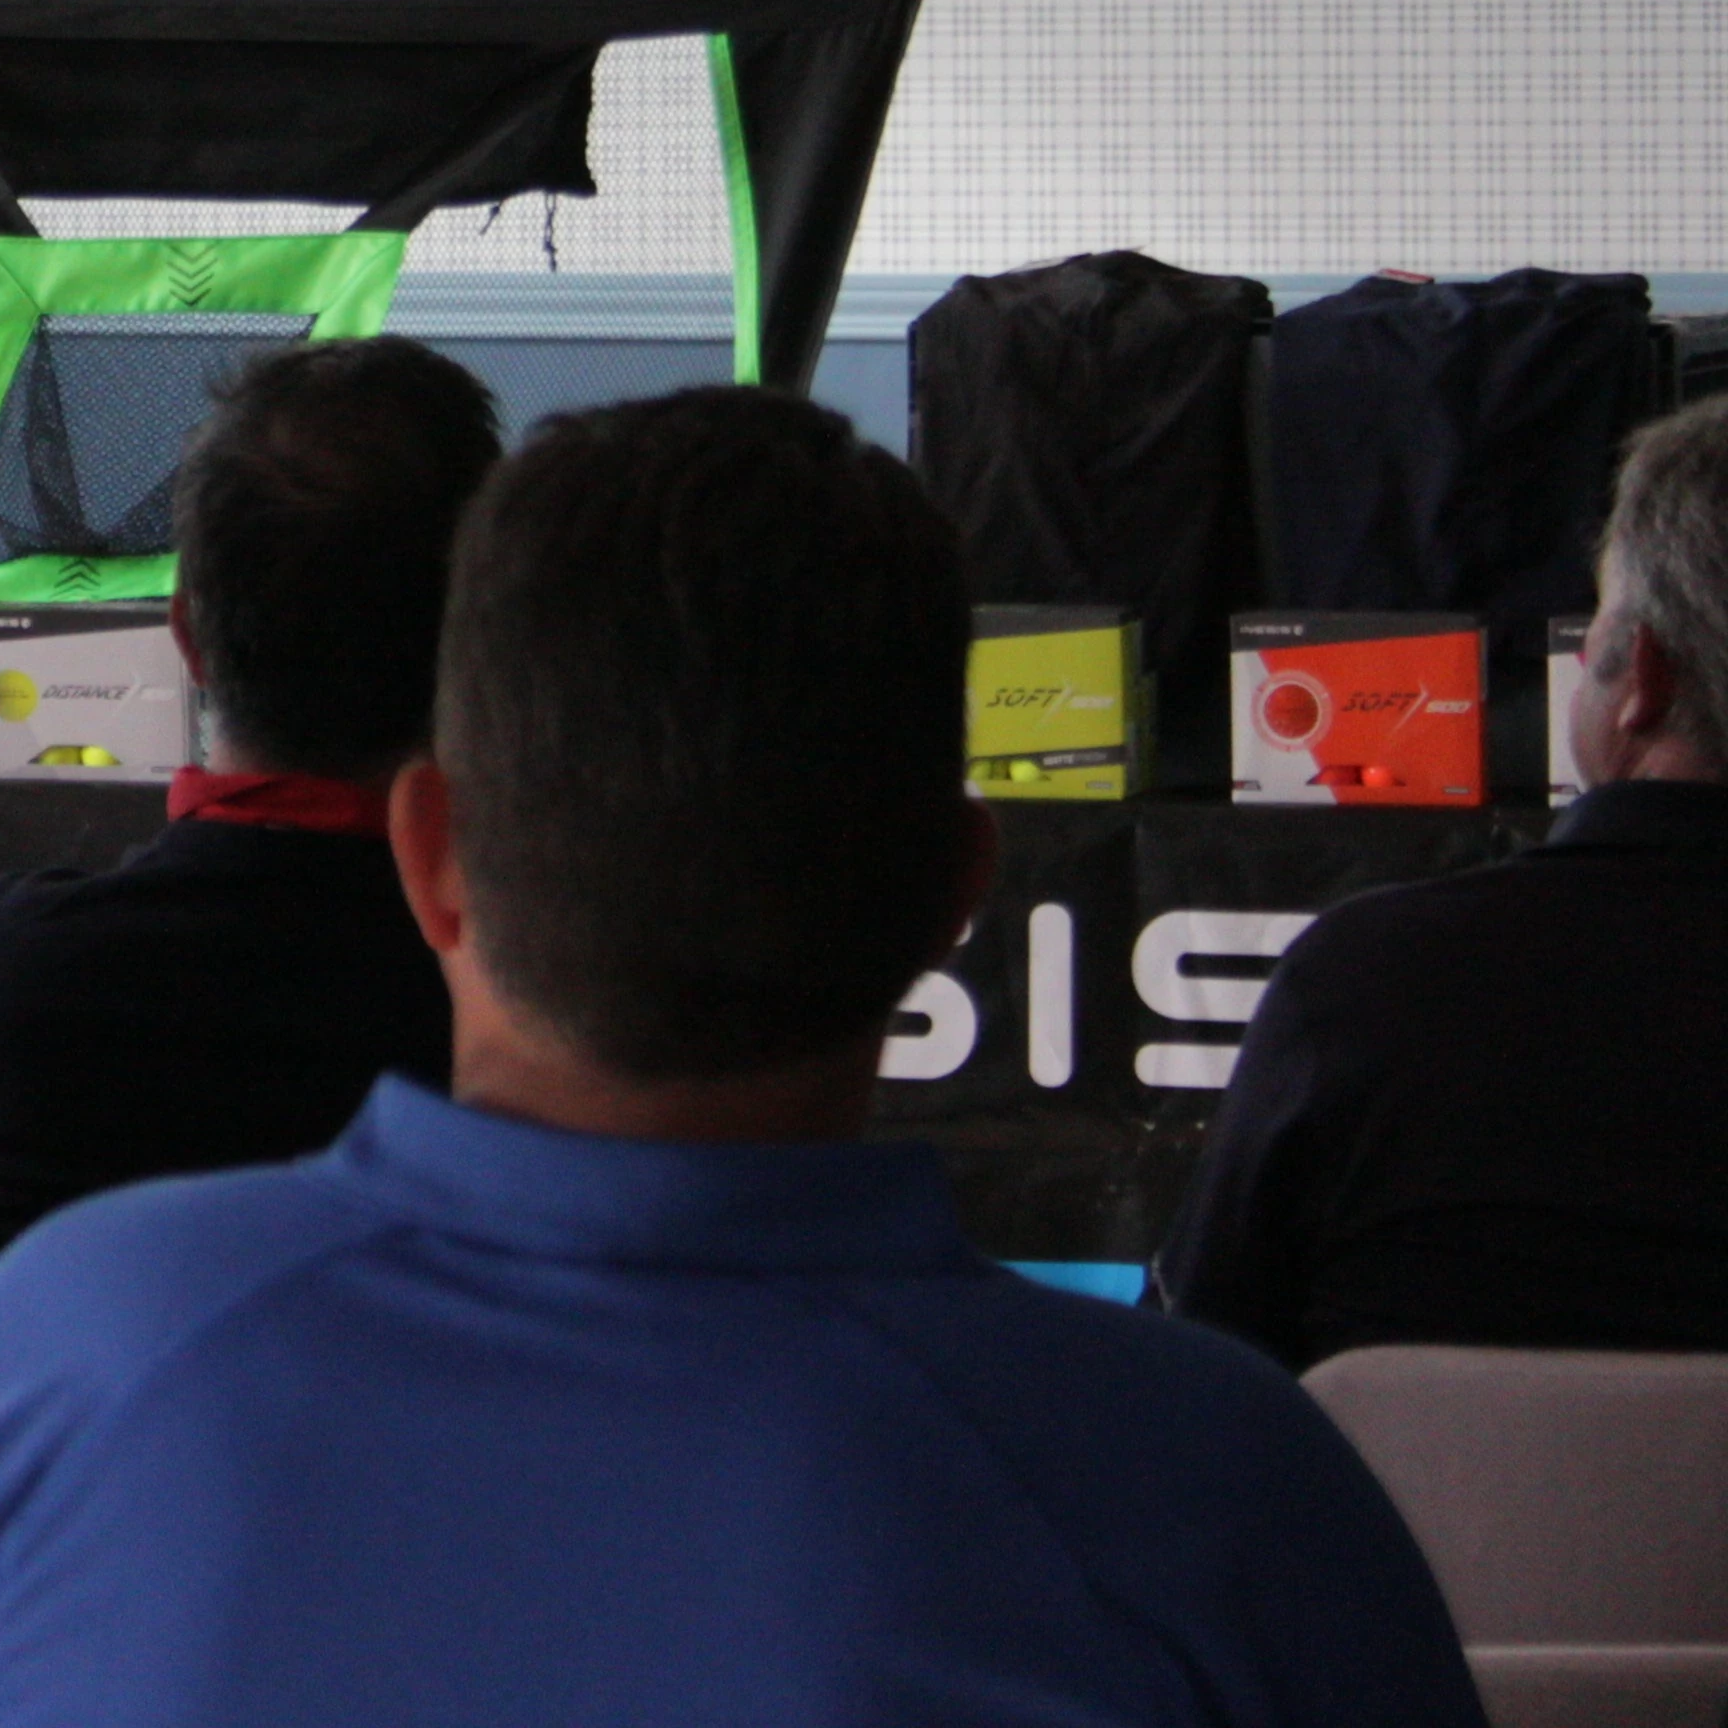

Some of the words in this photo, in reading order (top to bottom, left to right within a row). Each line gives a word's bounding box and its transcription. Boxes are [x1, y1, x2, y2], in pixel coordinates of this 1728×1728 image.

[42, 684, 130, 701] DISTANCE
[986, 687, 1063, 708] SOFT
[1340, 691, 1420, 712] SOFT
